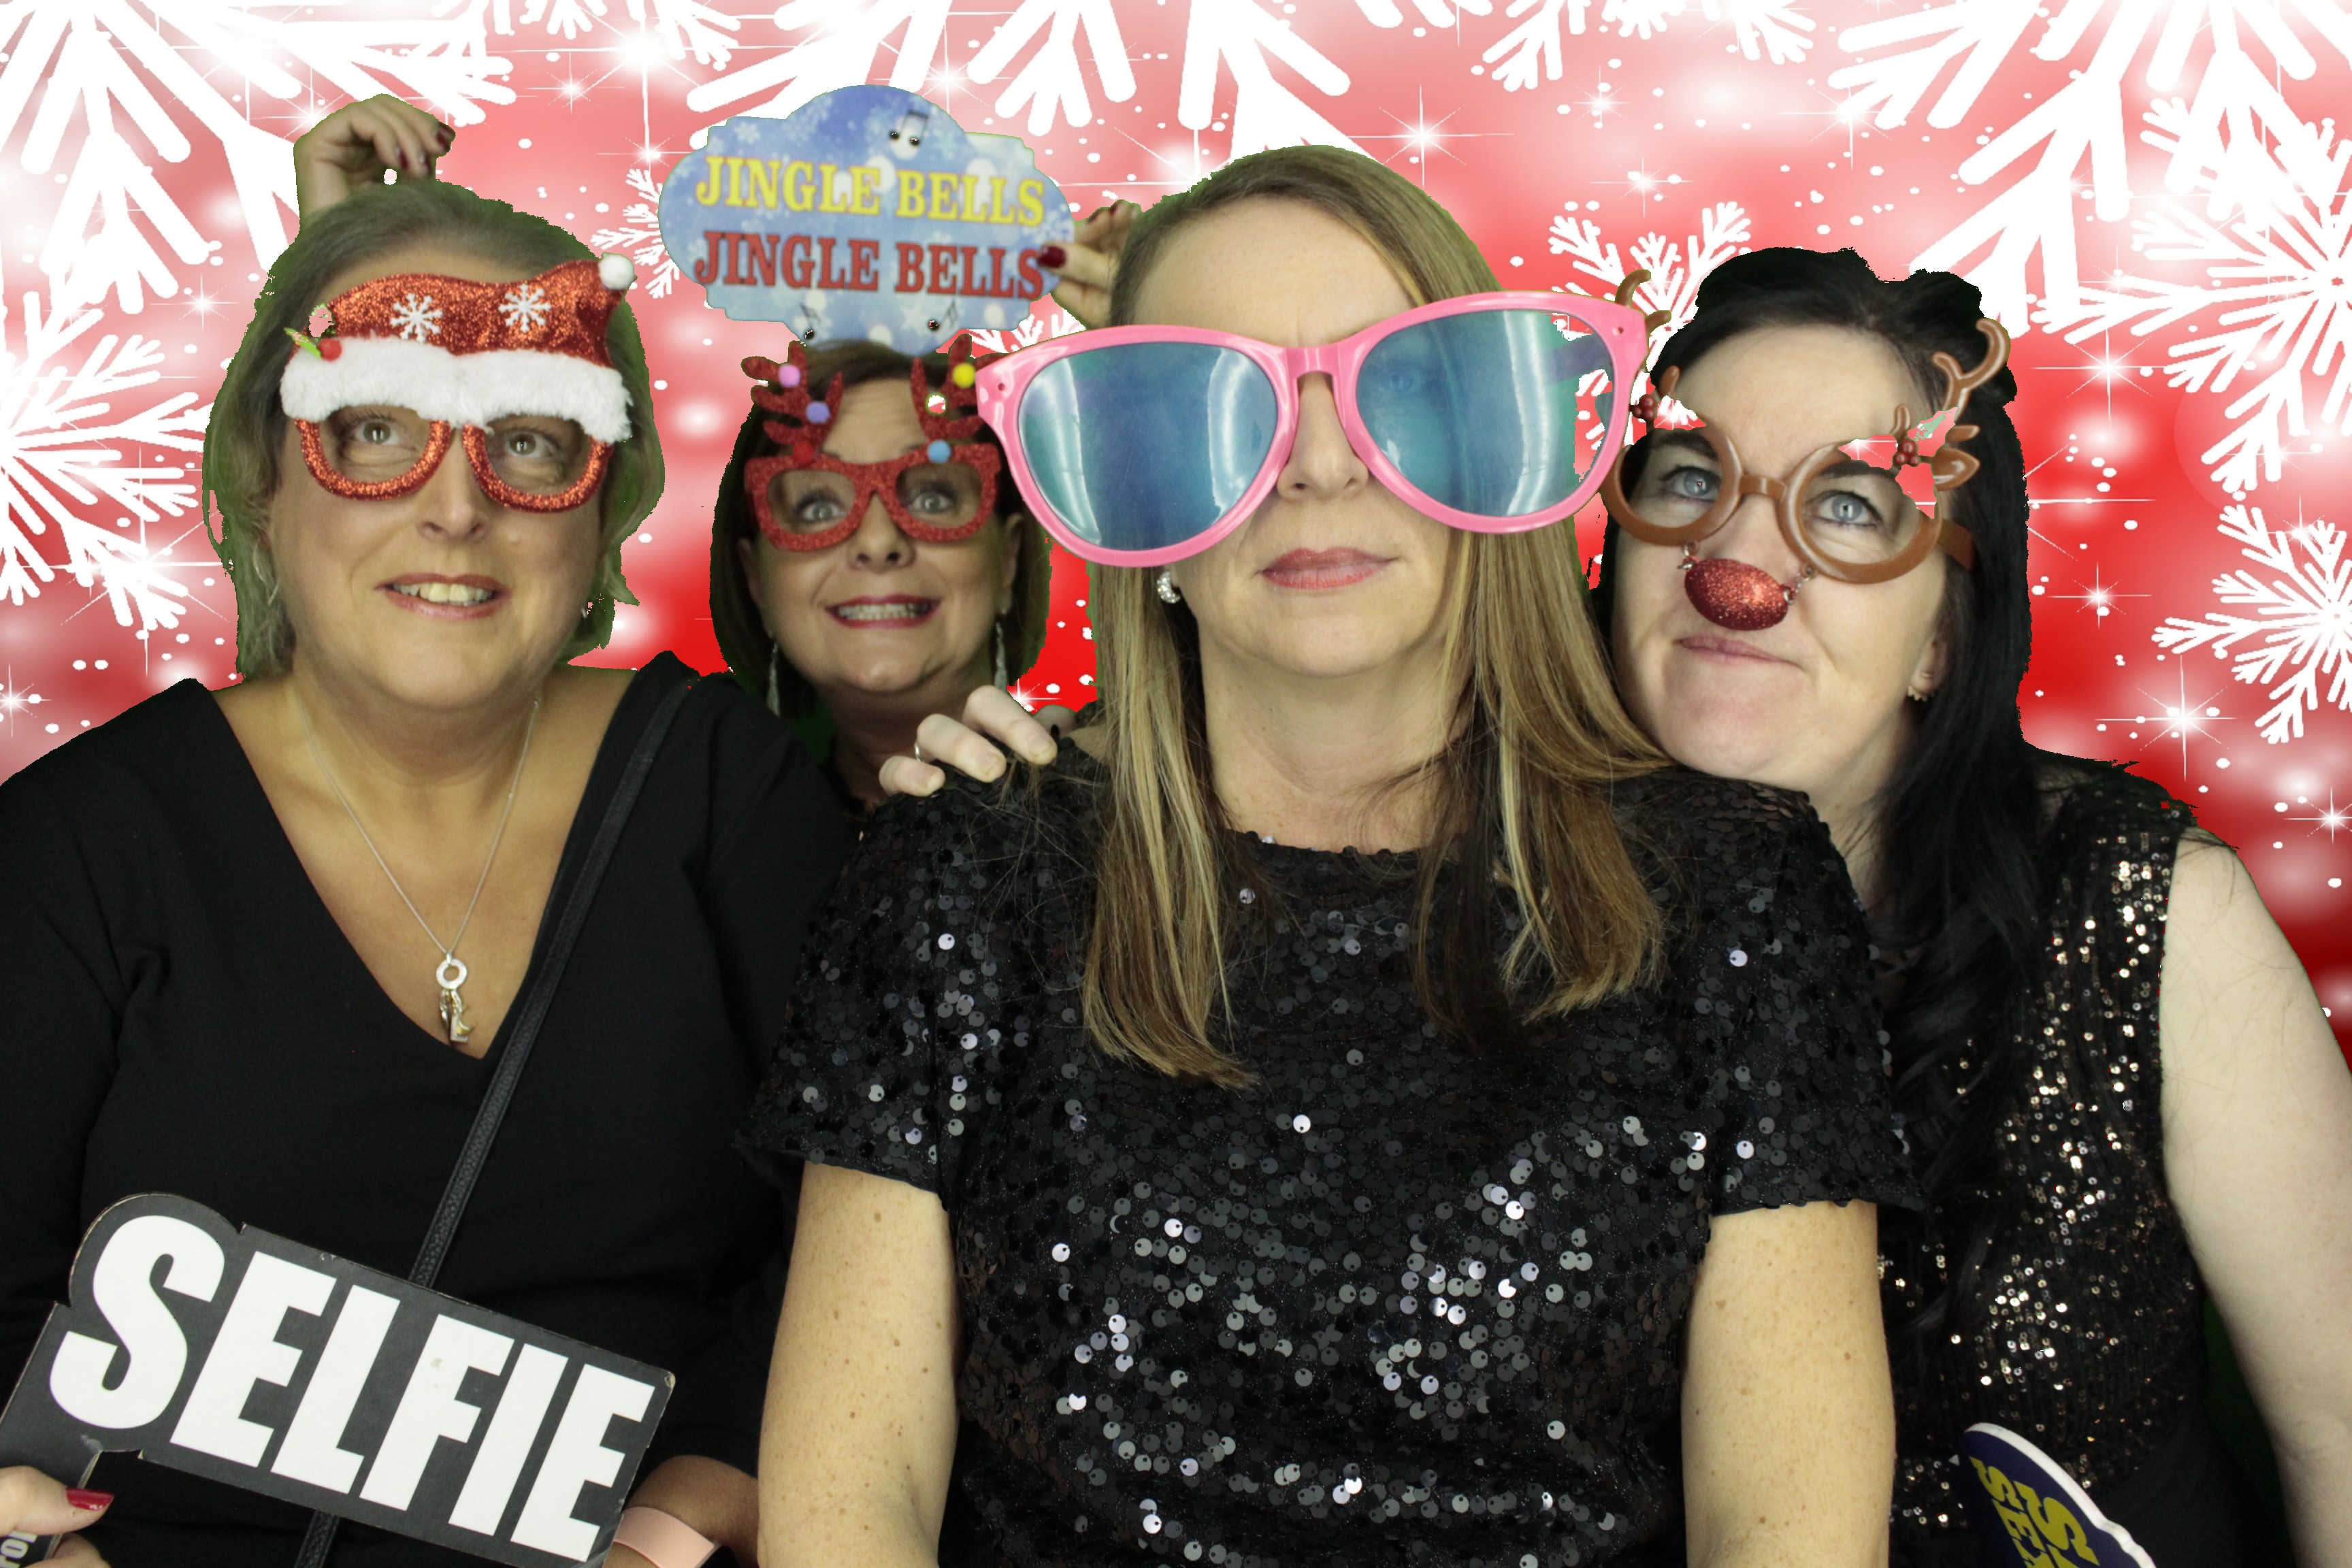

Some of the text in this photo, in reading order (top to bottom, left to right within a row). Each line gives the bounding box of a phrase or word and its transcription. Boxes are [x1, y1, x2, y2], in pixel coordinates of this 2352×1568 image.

[696, 155, 1045, 227] JINGLE BELLS
[693, 231, 1044, 300] JINGLE BELLS
[49, 1215, 655, 1563] SELFIE
[2012, 1480, 2100, 1568] S
